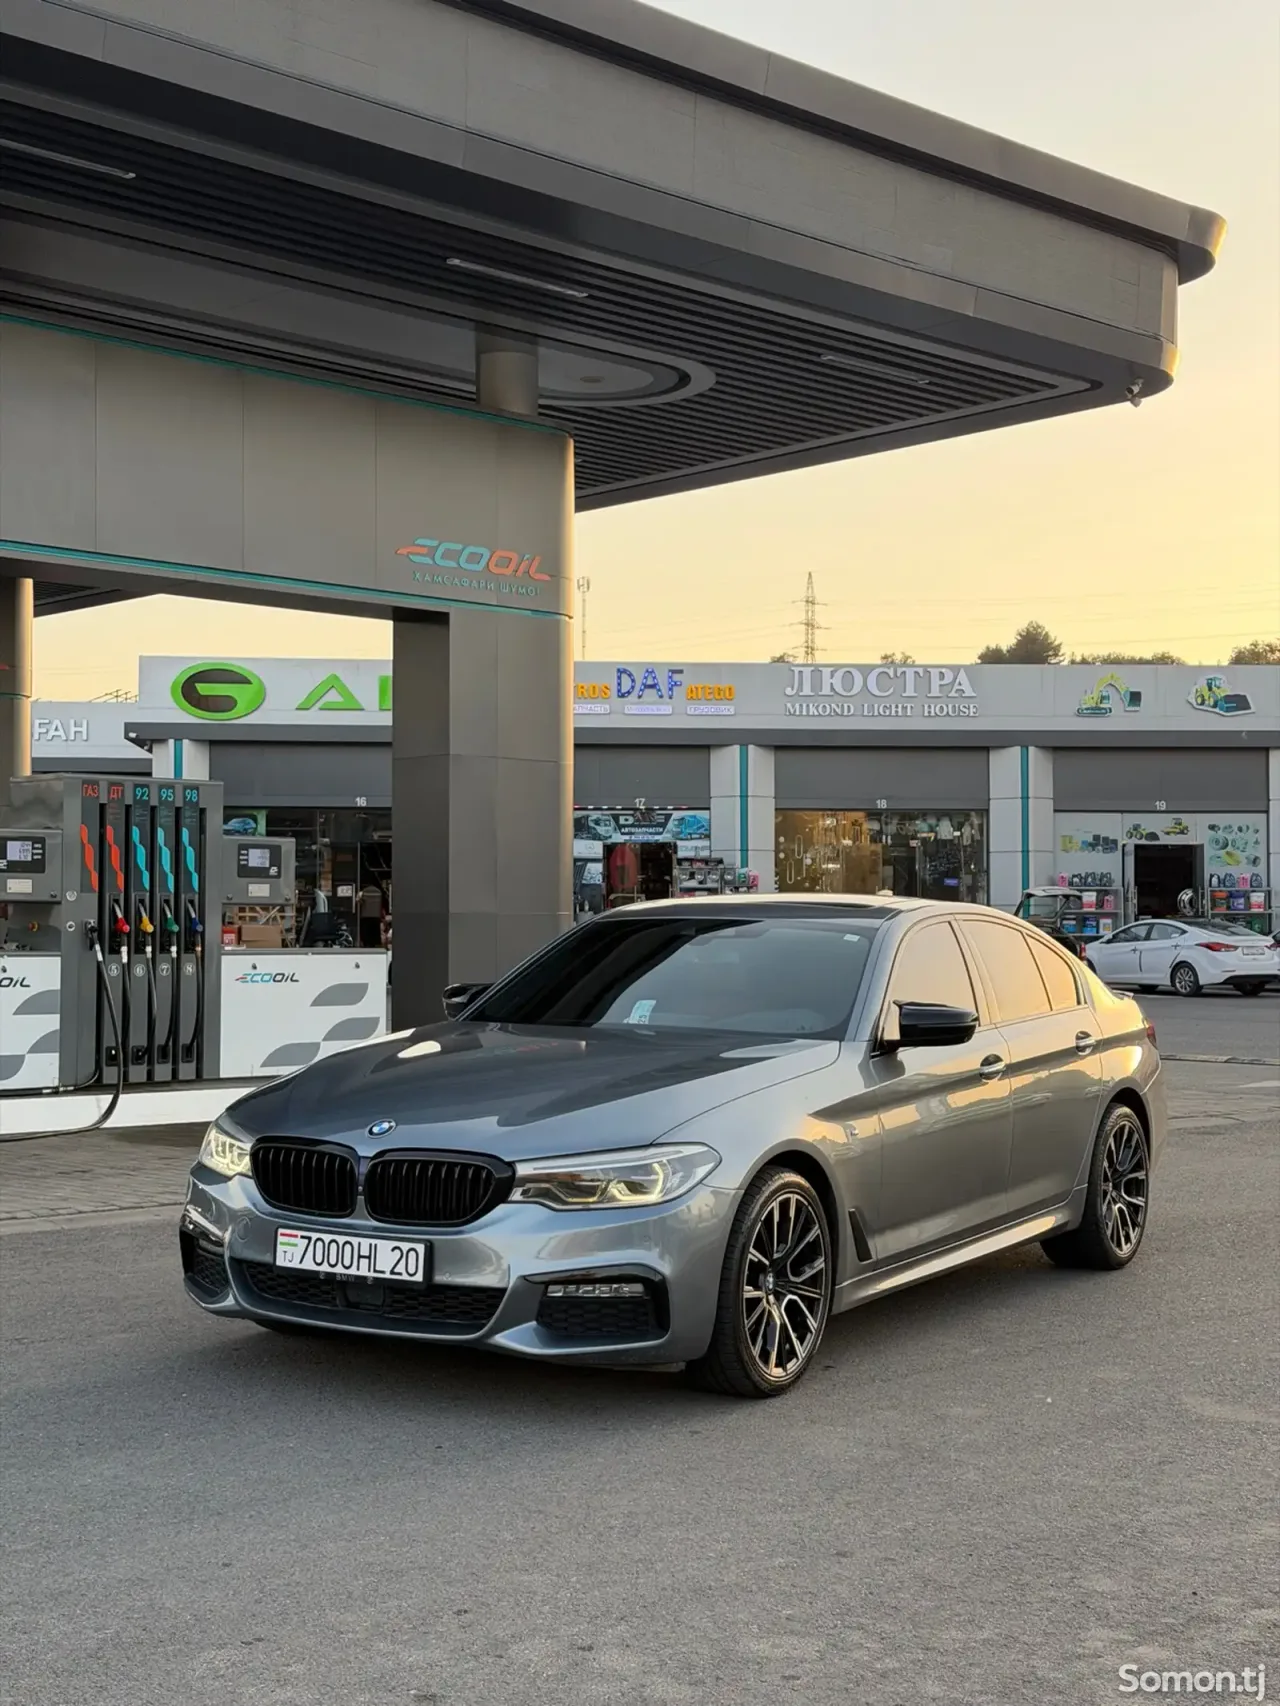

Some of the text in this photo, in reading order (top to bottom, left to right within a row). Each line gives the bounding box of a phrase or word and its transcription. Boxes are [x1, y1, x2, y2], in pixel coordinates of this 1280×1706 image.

[574, 667, 735, 701] ROS DAF ATEGO
[784, 666, 977, 698] ЛЮСТРА
[785, 703, 979, 718] MIKOND LIGHT HOUSE
[82, 784, 99, 797] ГАЗ
[109, 786, 124, 800] ДТ
[135, 787, 149, 800] 92
[160, 788, 174, 801] 95
[185, 789, 198, 802] 98
[355, 796, 367, 807] 16
[876, 799, 887, 809] 18
[1154, 800, 1166, 811] 19
[282, 1250, 295, 1263] TJ
